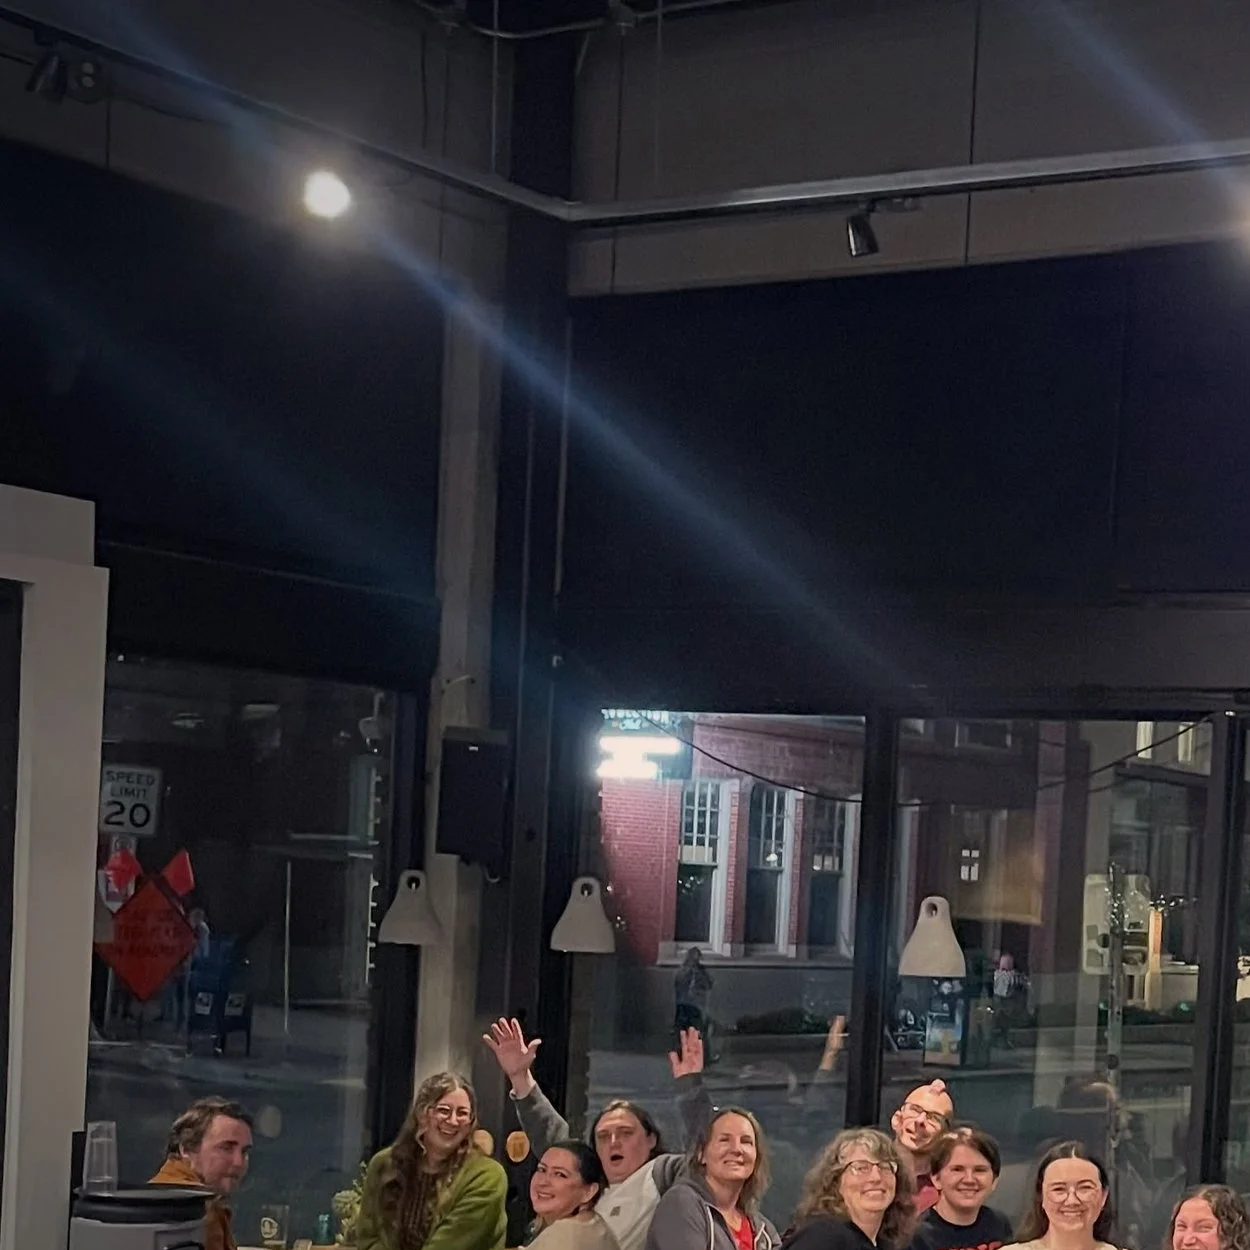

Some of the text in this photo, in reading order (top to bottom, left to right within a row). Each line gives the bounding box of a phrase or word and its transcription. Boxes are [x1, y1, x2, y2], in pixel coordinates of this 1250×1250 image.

[105, 770, 155, 787] SPEED
[110, 785, 148, 799] LIMIT
[104, 800, 151, 828] 20
